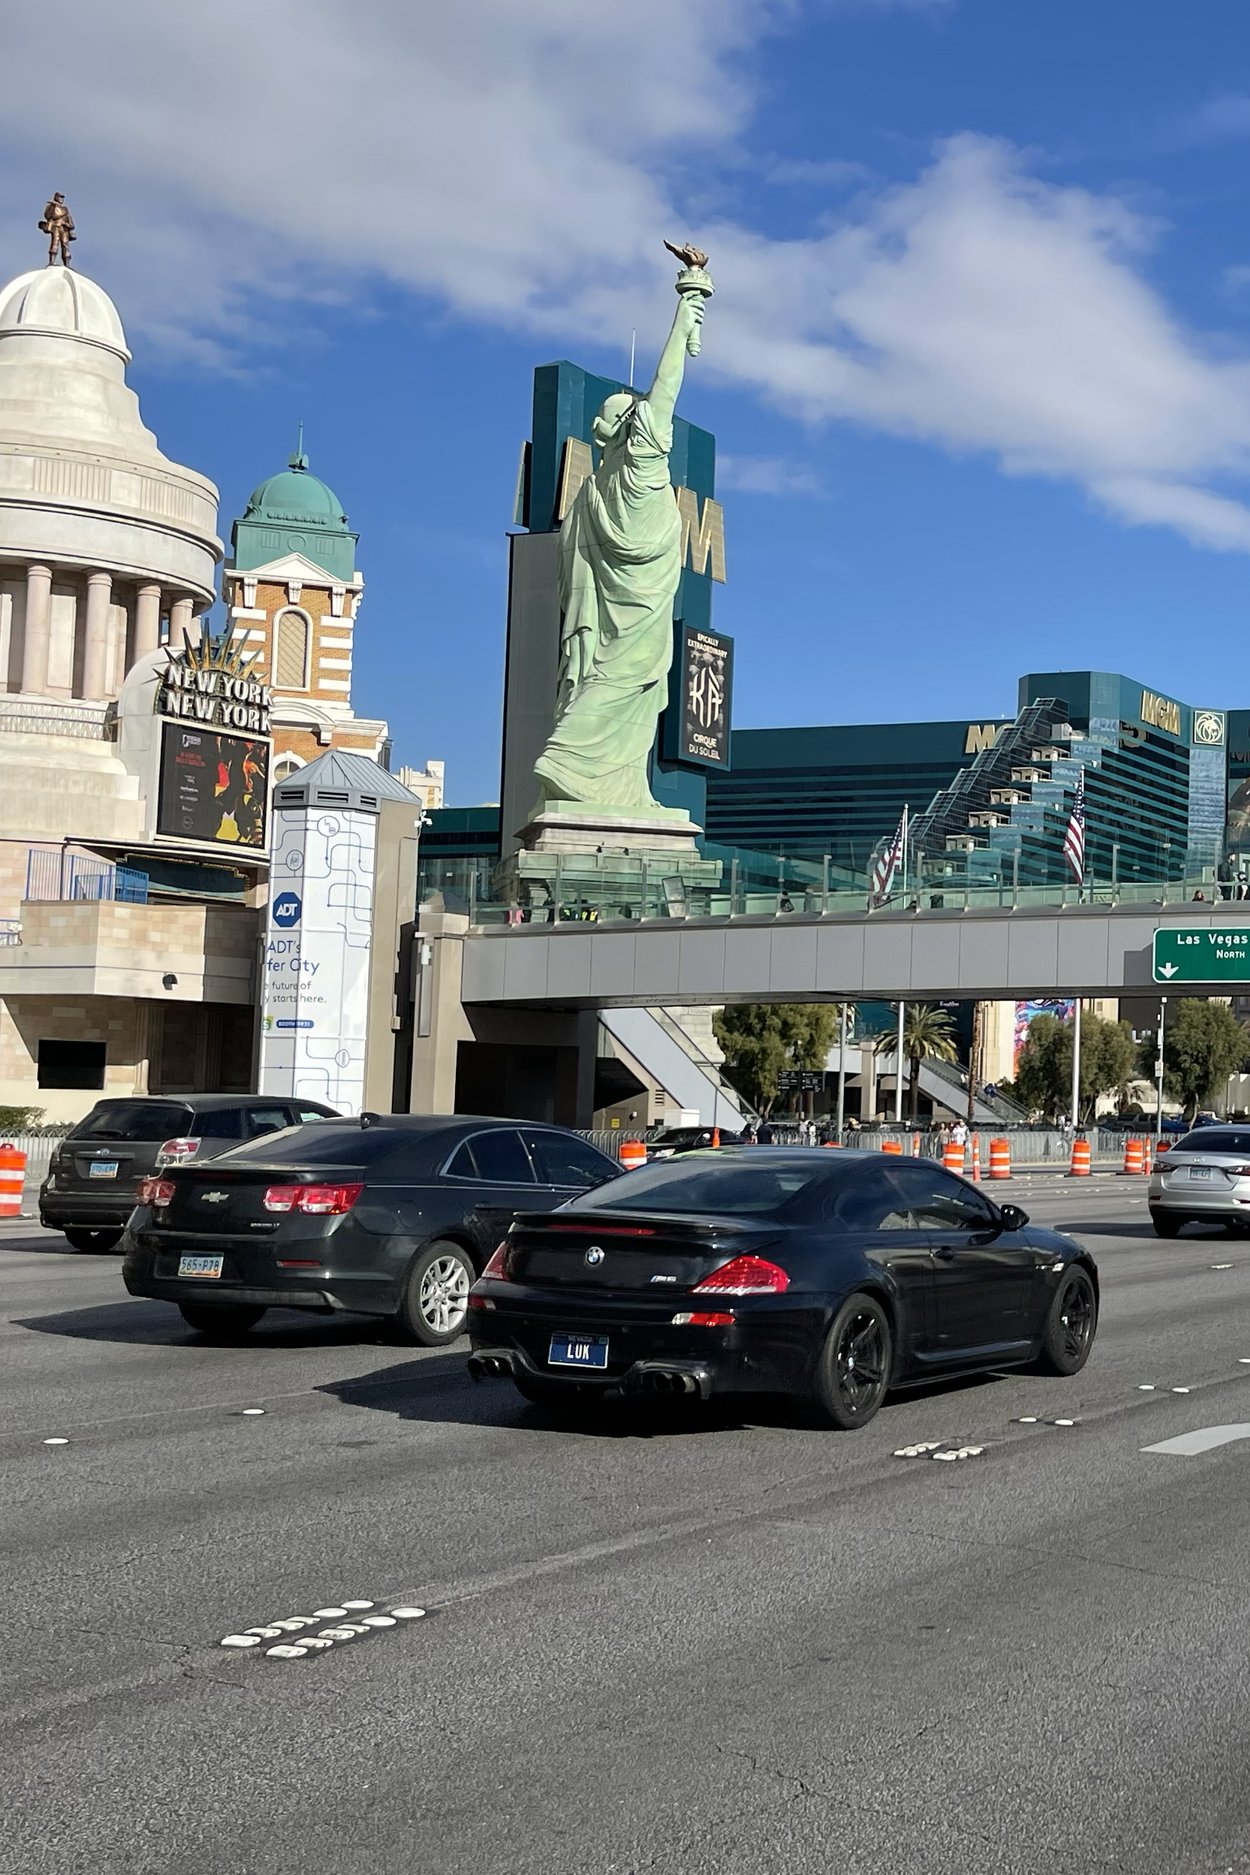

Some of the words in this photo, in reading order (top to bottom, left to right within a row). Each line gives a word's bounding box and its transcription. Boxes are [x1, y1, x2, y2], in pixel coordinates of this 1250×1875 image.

[687, 638, 728, 659] EXTRAORDINARY
[167, 663, 218, 693] NEW
[223, 676, 273, 706] YORK
[166, 688, 217, 720] NEW
[222, 701, 272, 732] YORK
[1141, 689, 1181, 736] MGM
[693, 733, 717, 749] CIRQUE
[688, 743, 699, 755] DU
[700, 746, 720, 761] SOLEIL
[276, 904, 297, 917] ADT
[1177, 934, 1200, 945] Las
[1208, 933, 1249, 947] Vegas
[1216, 950, 1246, 959] NORTH
[300, 981, 312, 990] of
